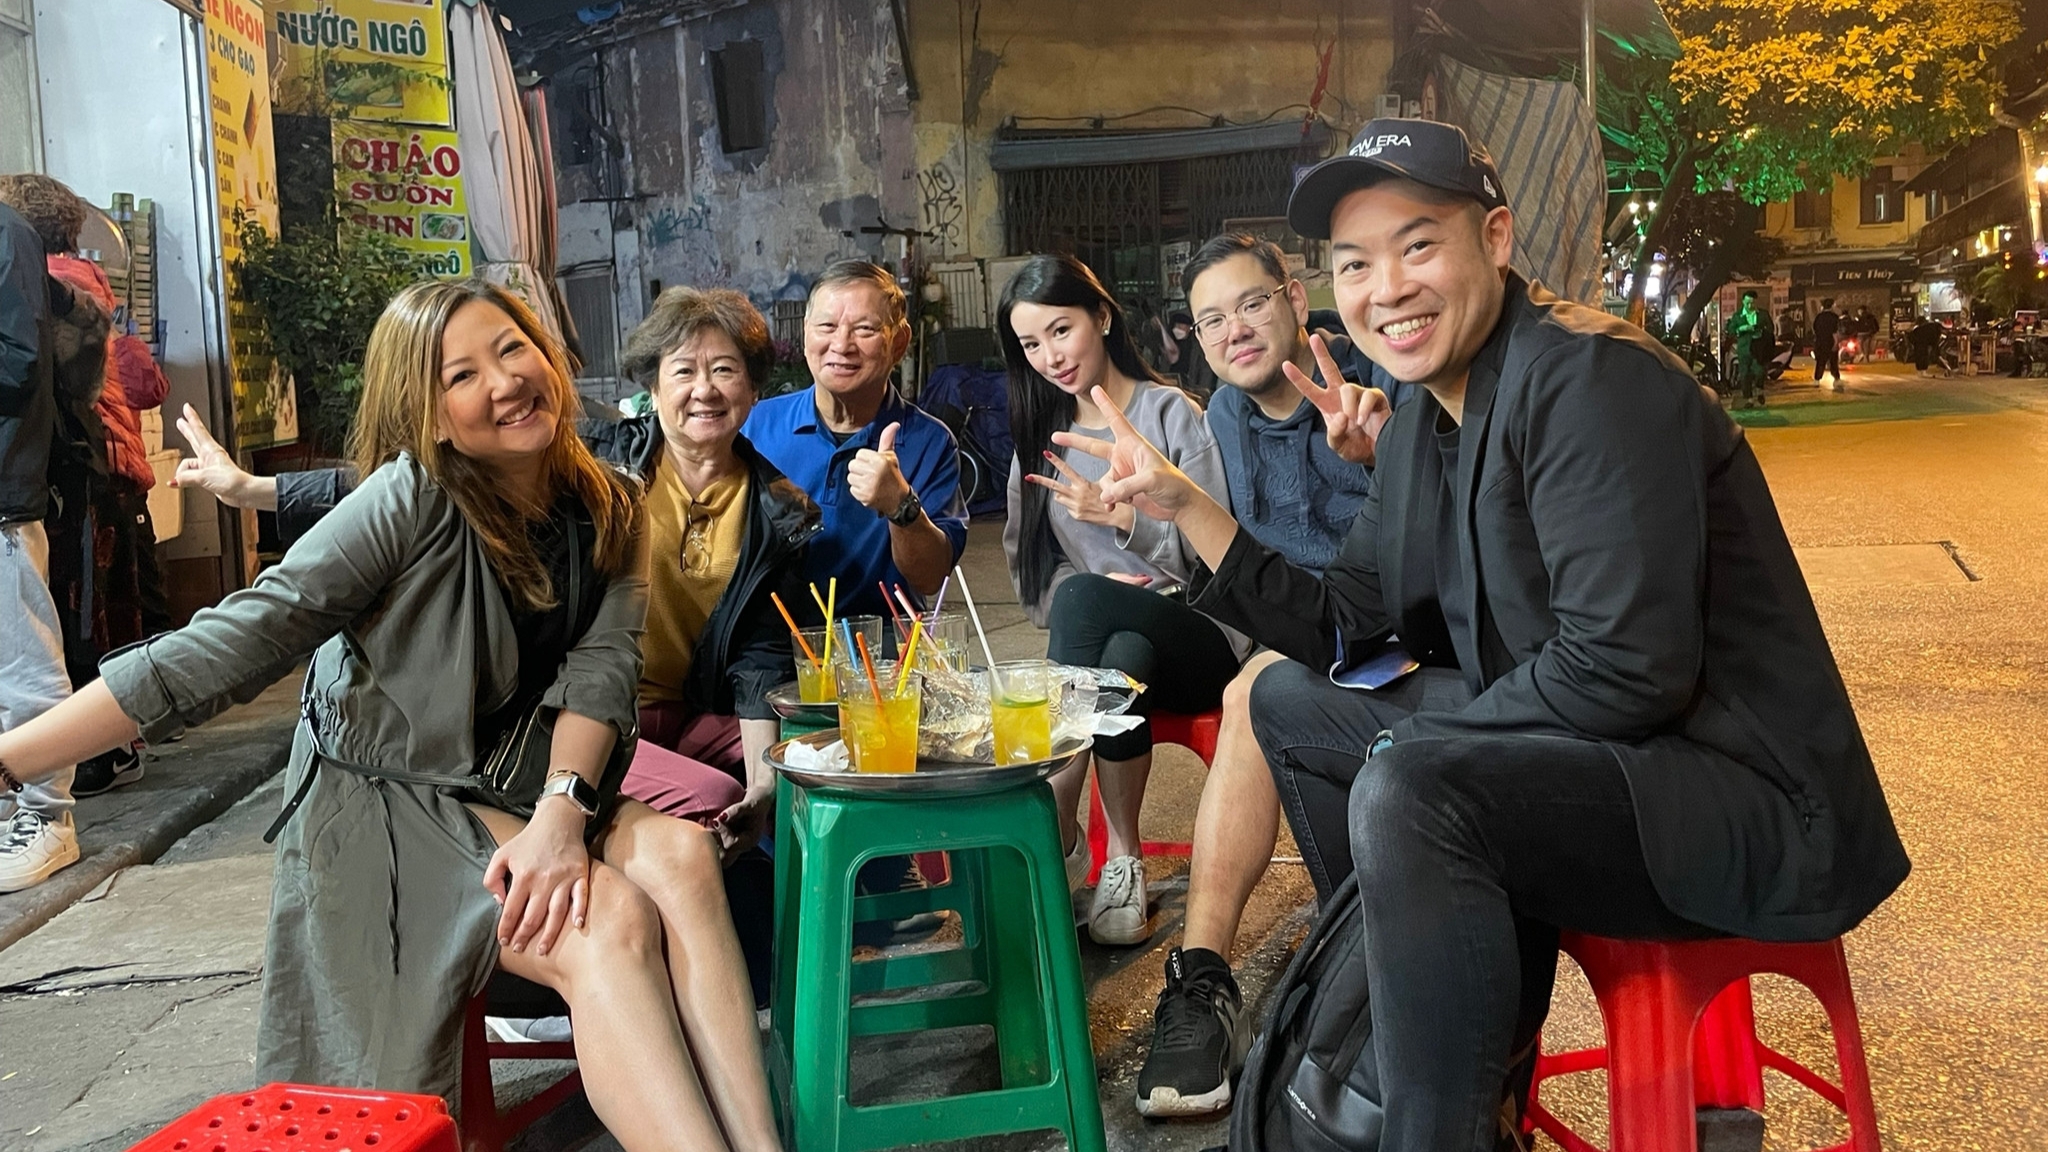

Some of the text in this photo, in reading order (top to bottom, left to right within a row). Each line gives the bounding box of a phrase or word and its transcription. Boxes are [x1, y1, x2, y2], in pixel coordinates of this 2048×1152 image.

[224, 0, 264, 49] NGON
[277, 7, 427, 57] NƯỚC NGÔ
[341, 133, 461, 178] CHÁO
[1375, 134, 1412, 148] ERA
